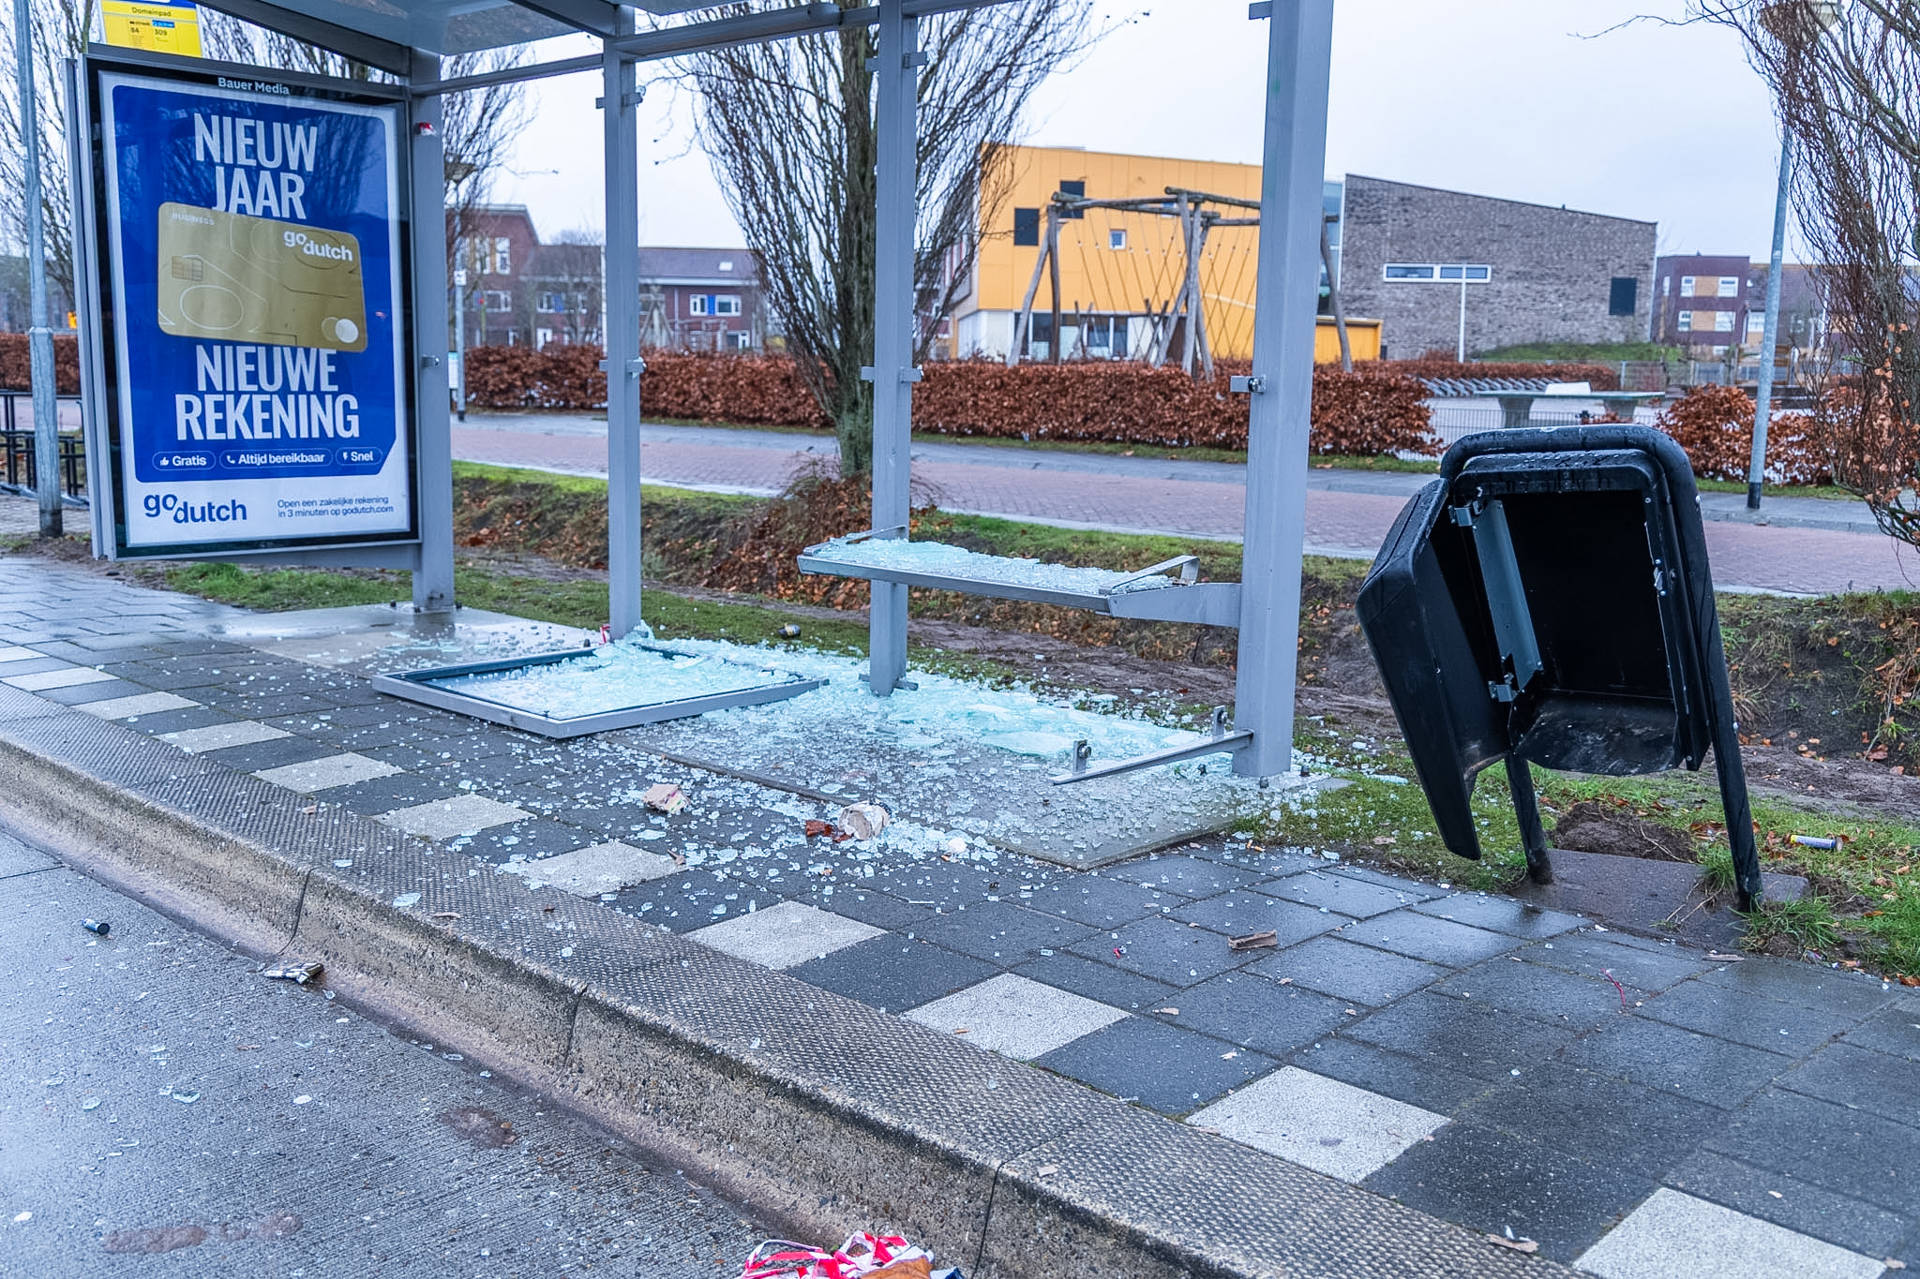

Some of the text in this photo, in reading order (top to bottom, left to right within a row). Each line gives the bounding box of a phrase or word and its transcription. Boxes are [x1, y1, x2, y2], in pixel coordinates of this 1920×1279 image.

[217, 77, 290, 95] Bauer Media
[194, 112, 318, 172] NIEUW
[211, 165, 307, 220] JAAR
[195, 344, 339, 392] NIEUWE
[175, 393, 360, 441] REKENING
[172, 454, 207, 467] Gratis
[238, 452, 325, 466] Altijd bereikbaar
[350, 450, 374, 462] Snel
[277, 496, 389, 509] Open een zakelijke rekening
[287, 509, 294, 518] 3
[295, 507, 329, 516] minuten
[330, 507, 341, 516] op
[342, 504, 394, 516] godutch.com
